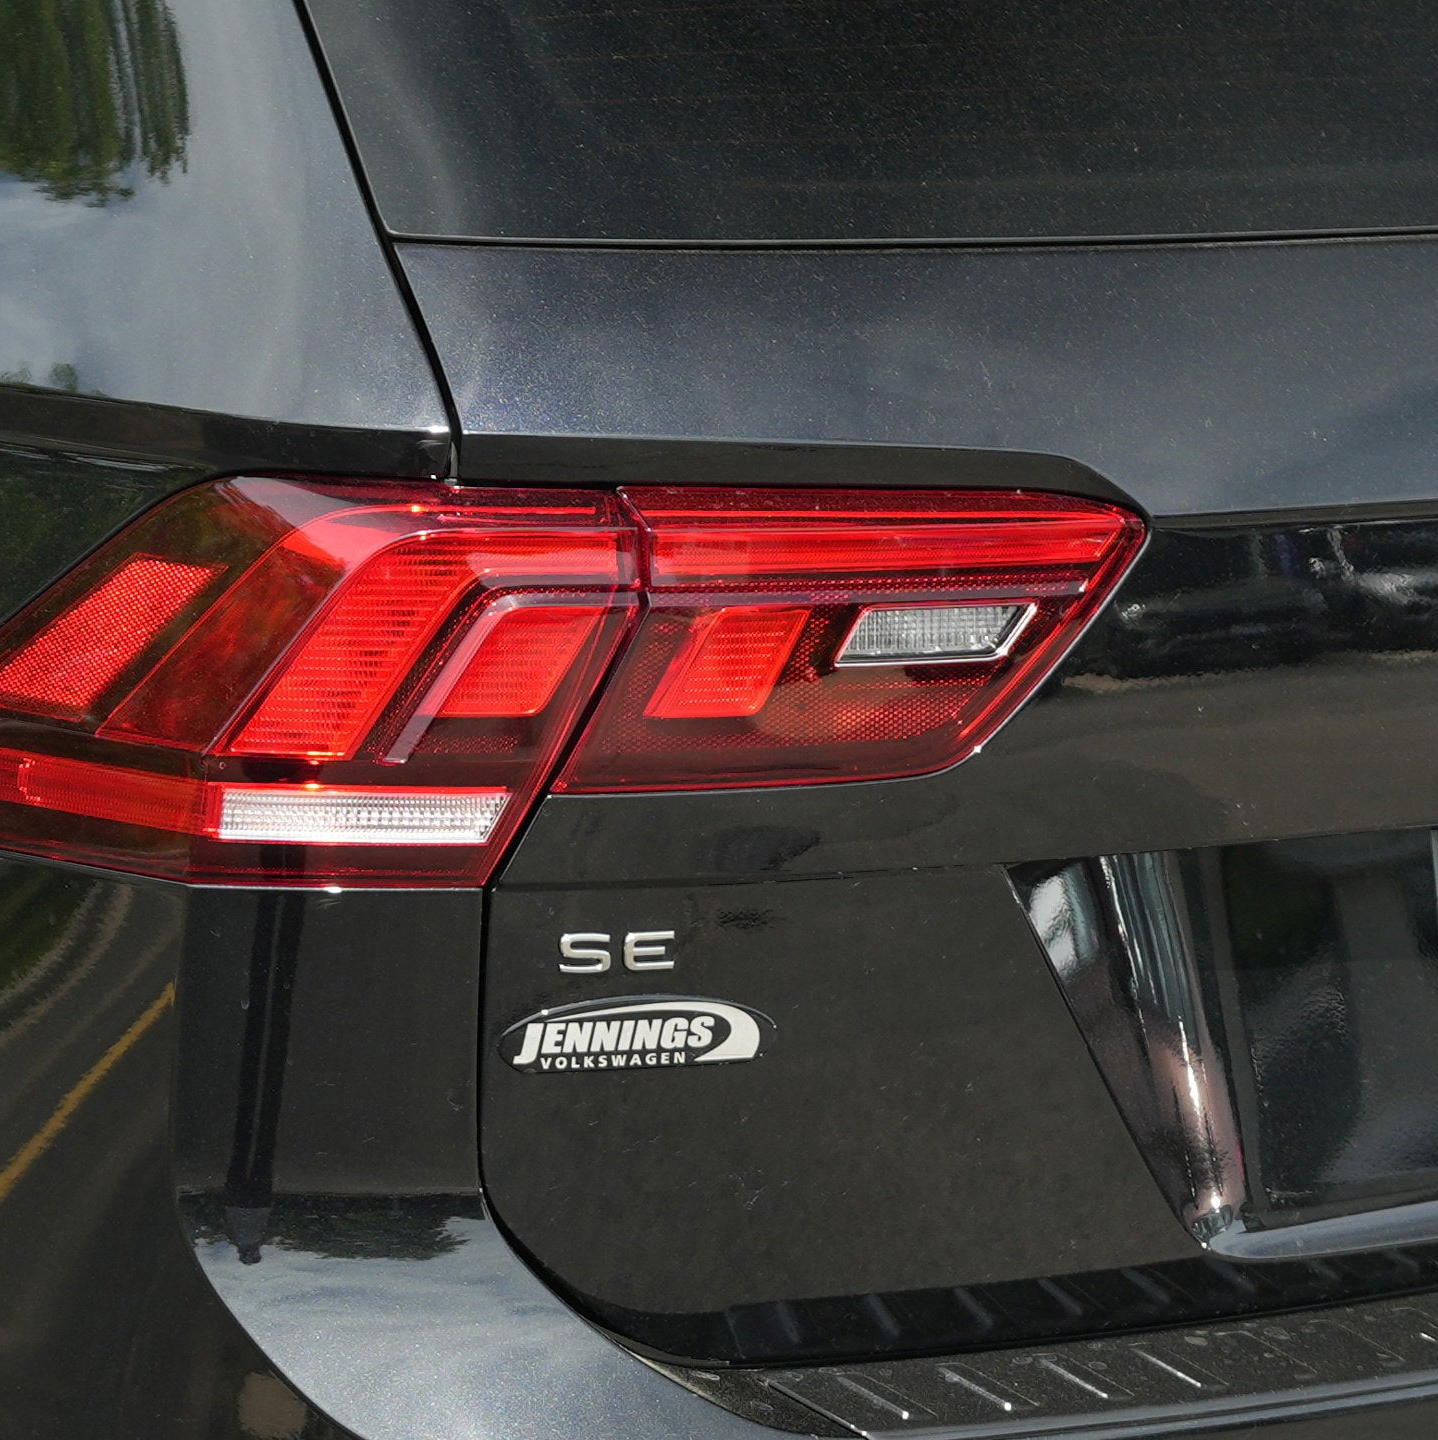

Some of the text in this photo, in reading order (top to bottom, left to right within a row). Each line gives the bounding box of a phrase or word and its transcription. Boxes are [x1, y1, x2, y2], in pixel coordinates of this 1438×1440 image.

[558, 930, 675, 974] SE
[512, 1014, 715, 1065] JENNINGS
[540, 1050, 686, 1070] VOLKSWAGEN
